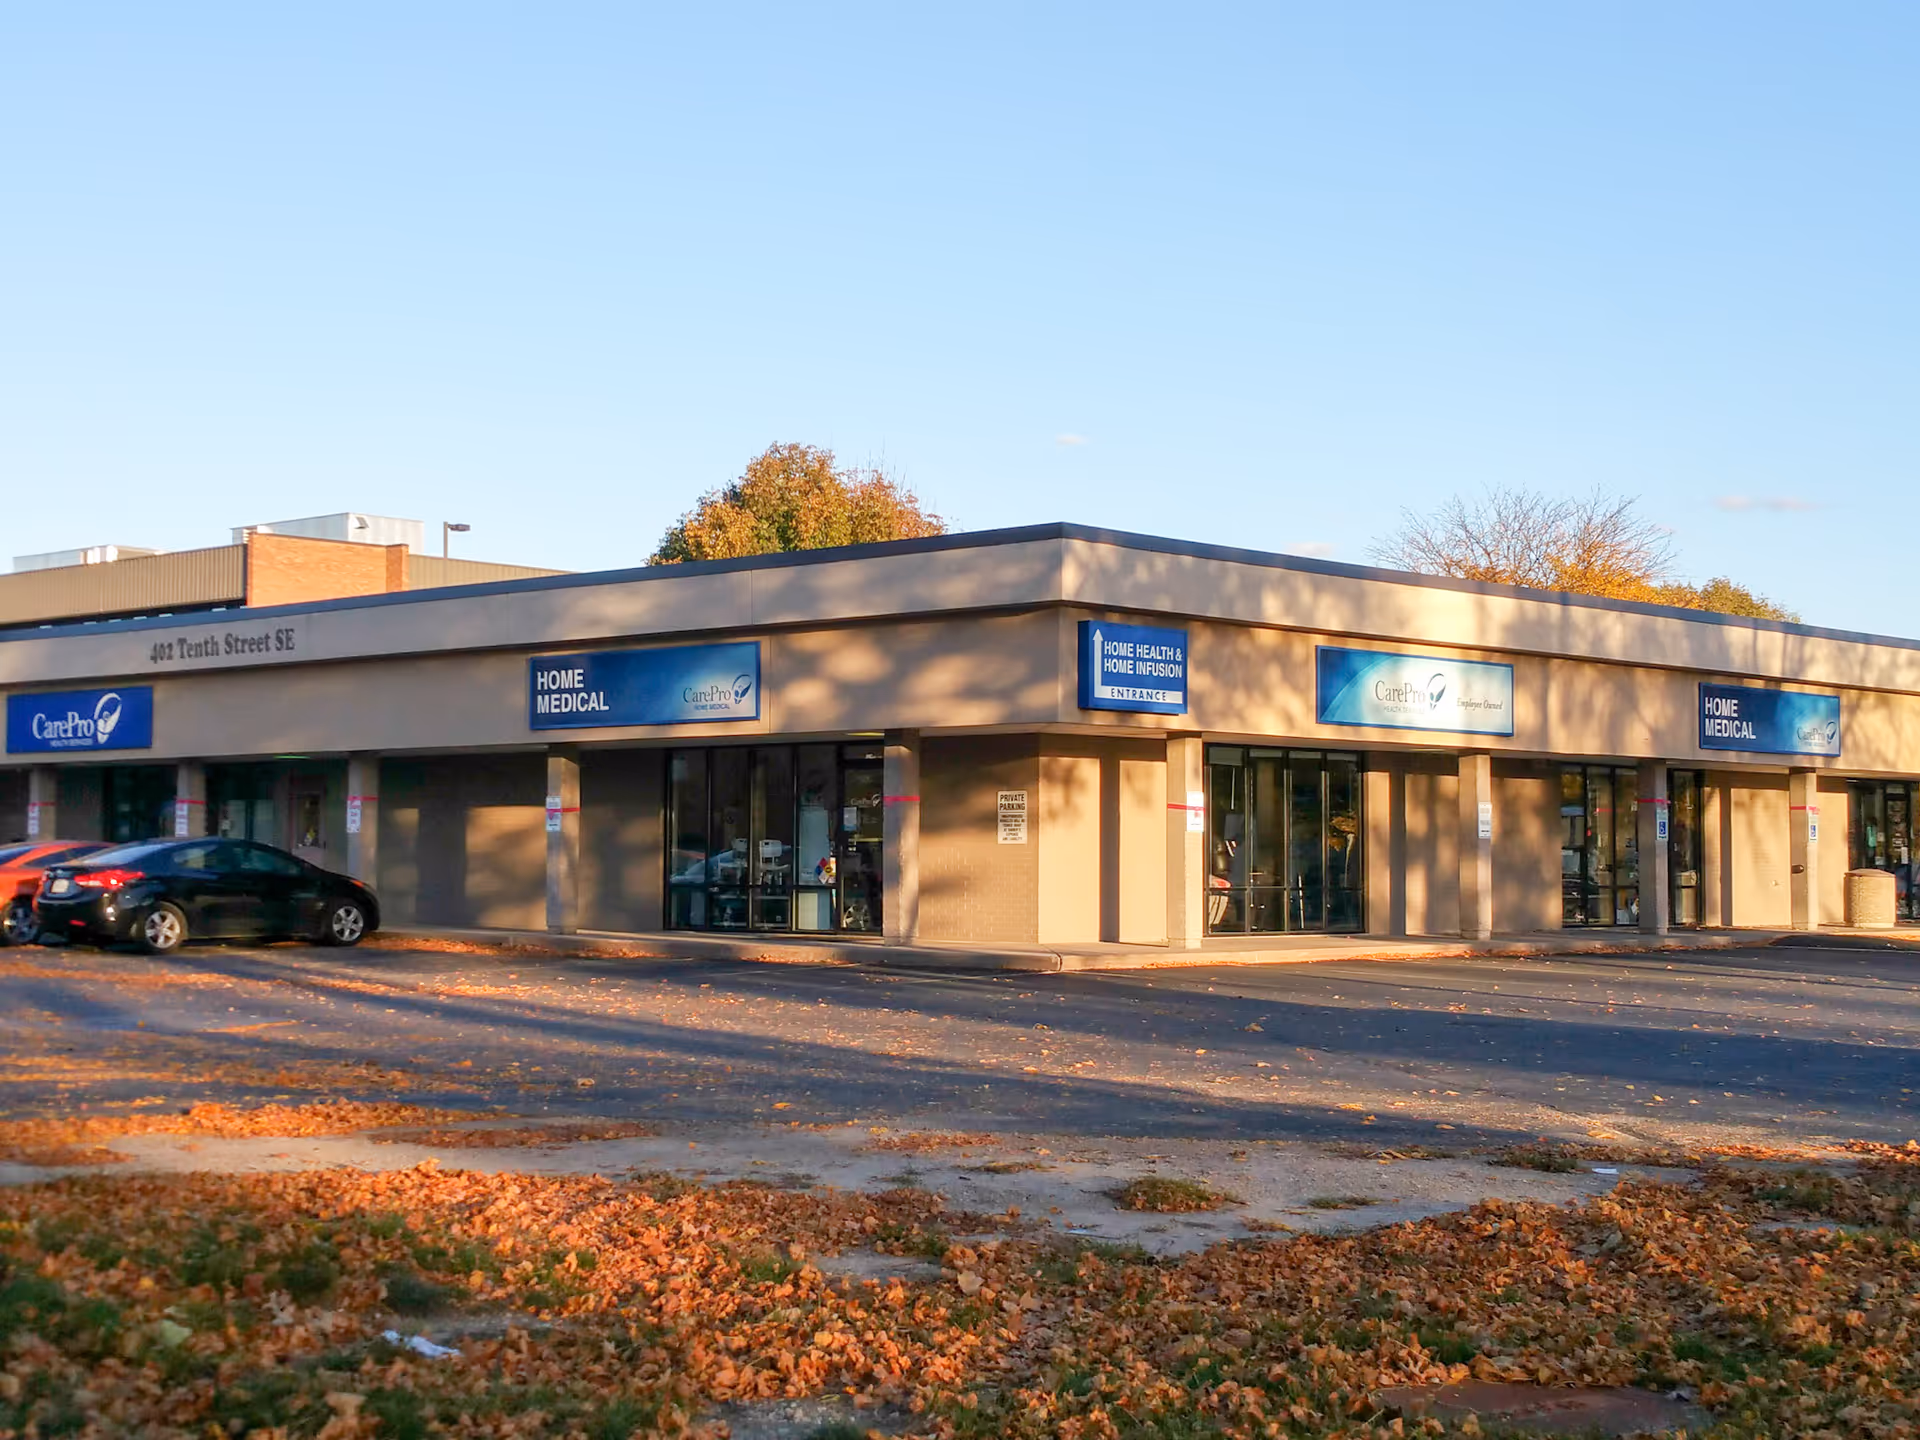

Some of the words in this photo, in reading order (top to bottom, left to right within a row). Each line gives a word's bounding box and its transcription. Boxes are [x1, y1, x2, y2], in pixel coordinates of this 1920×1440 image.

[150, 642, 174, 664] 402
[177, 635, 220, 659] Tenth
[224, 632, 271, 655] Street
[275, 628, 296, 651] SE
[1104, 641, 1134, 657] HOME
[1136, 643, 1174, 660] HEALTH
[1175, 648, 1183, 661] &
[1104, 658, 1134, 674] HOME
[1136, 660, 1183, 679] INFUSION
[537, 669, 584, 690] HOME
[537, 691, 610, 714] MEDICAL
[682, 685, 732, 704] CarePro
[1111, 688, 1167, 701] ENTRANCE
[1375, 680, 1426, 704] CarePro
[1705, 697, 1738, 717] HOME
[32, 711, 95, 740] CarePro
[1705, 718, 1756, 739] MEDICAL
[1000, 793, 1025, 802] PRIVATE
[1000, 802, 1025, 811] PARKING
